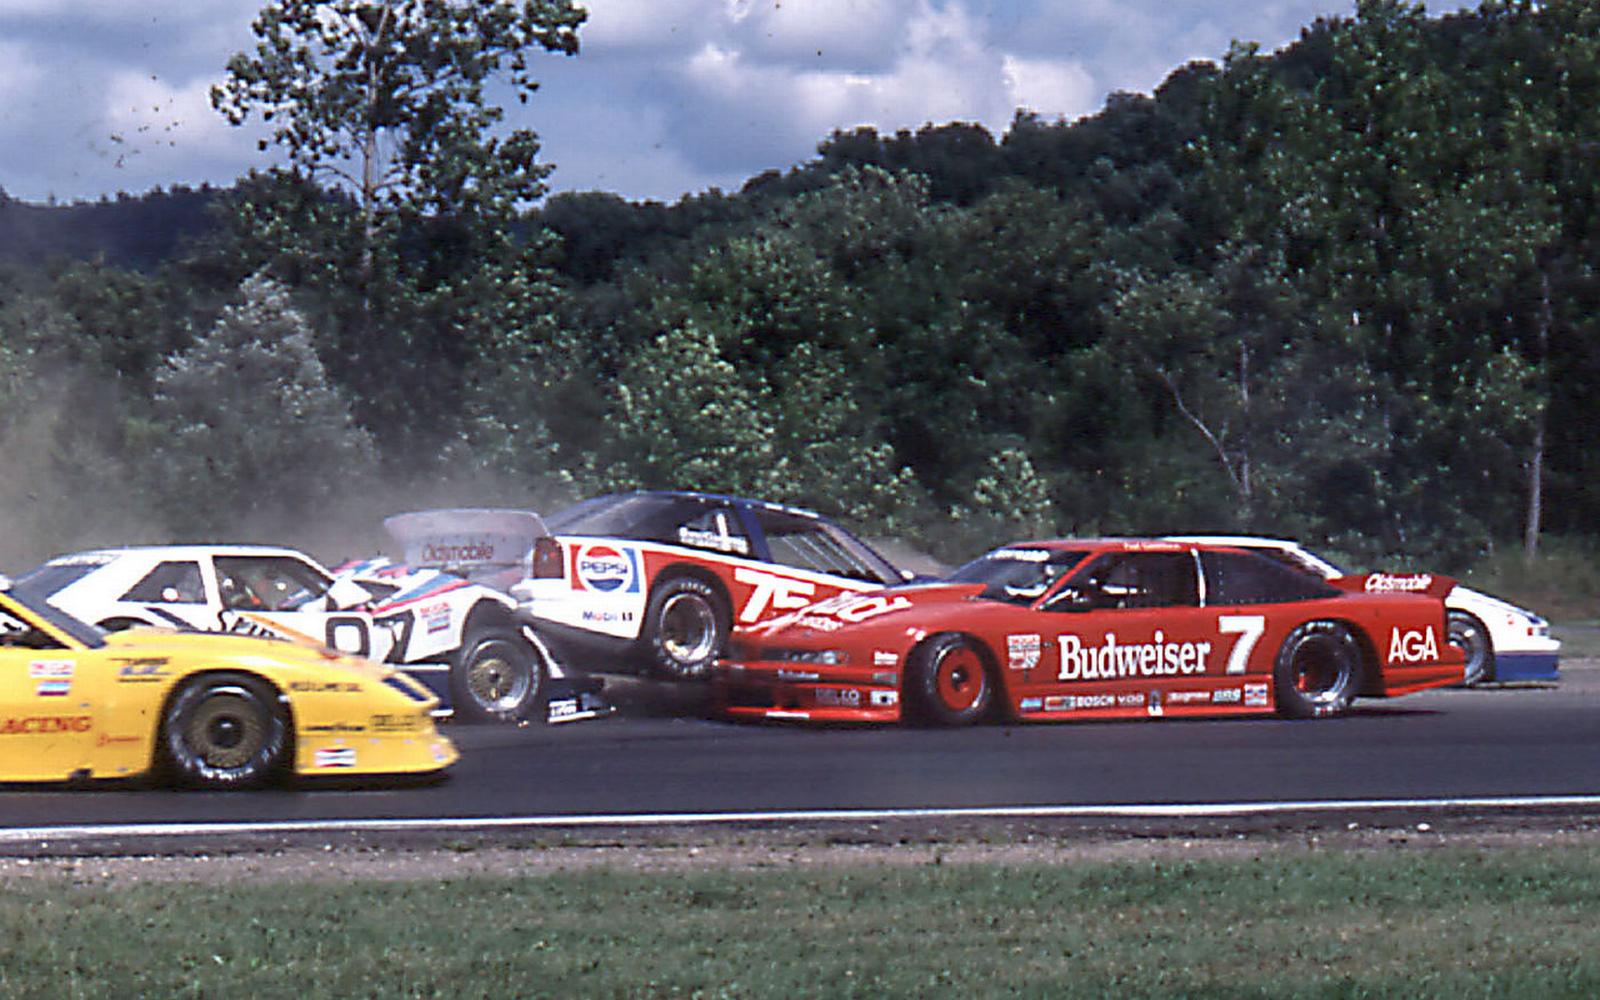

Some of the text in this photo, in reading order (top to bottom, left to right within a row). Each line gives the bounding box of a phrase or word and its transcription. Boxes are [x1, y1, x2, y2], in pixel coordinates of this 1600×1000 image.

[581, 561, 628, 574] PEPSI
[1057, 630, 1212, 680] Budweiser
[1218, 615, 1266, 675] 7
[1387, 625, 1439, 664] AGA
